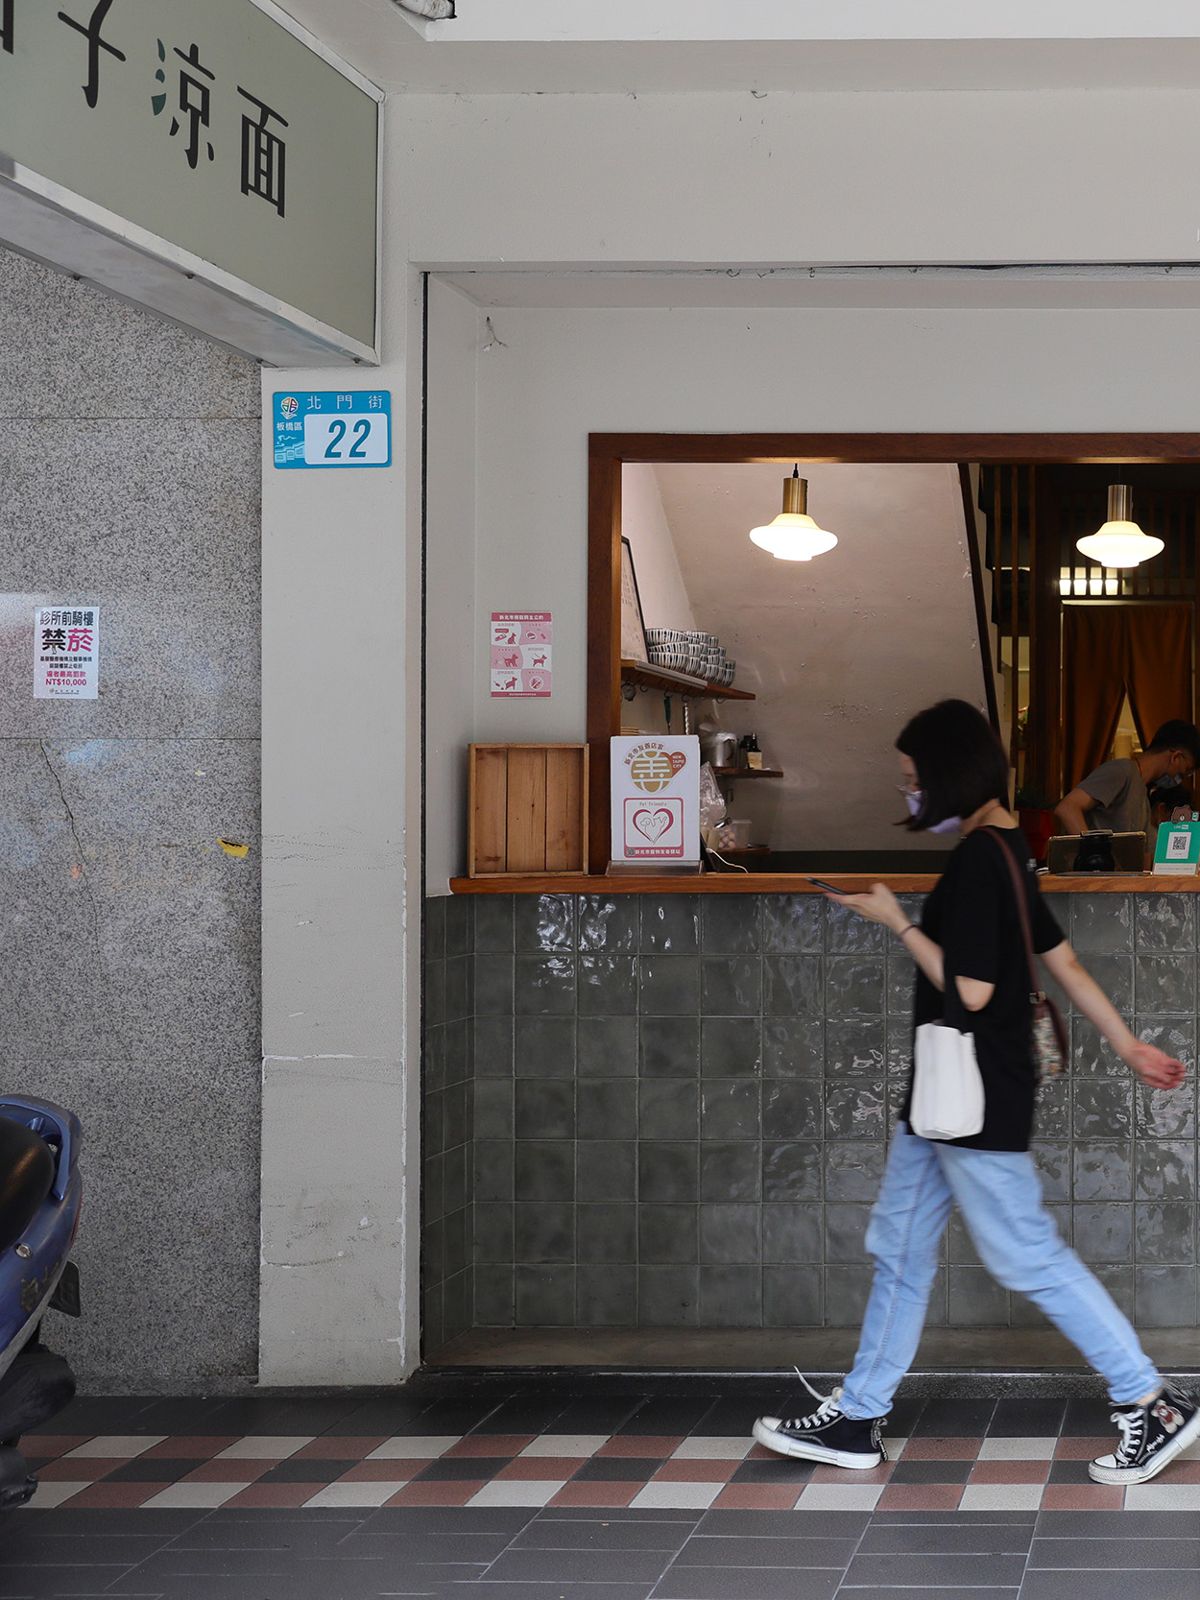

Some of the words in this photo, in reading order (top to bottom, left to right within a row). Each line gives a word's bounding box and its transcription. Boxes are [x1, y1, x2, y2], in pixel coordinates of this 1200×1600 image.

[0, 0, 289, 218] 子涼面
[307, 395, 383, 410] 北門街
[276, 421, 303, 431] 板橋區
[324, 419, 371, 459] 22
[41, 628, 94, 654] 禁菸
[46, 679, 87, 687] NT$10,000
